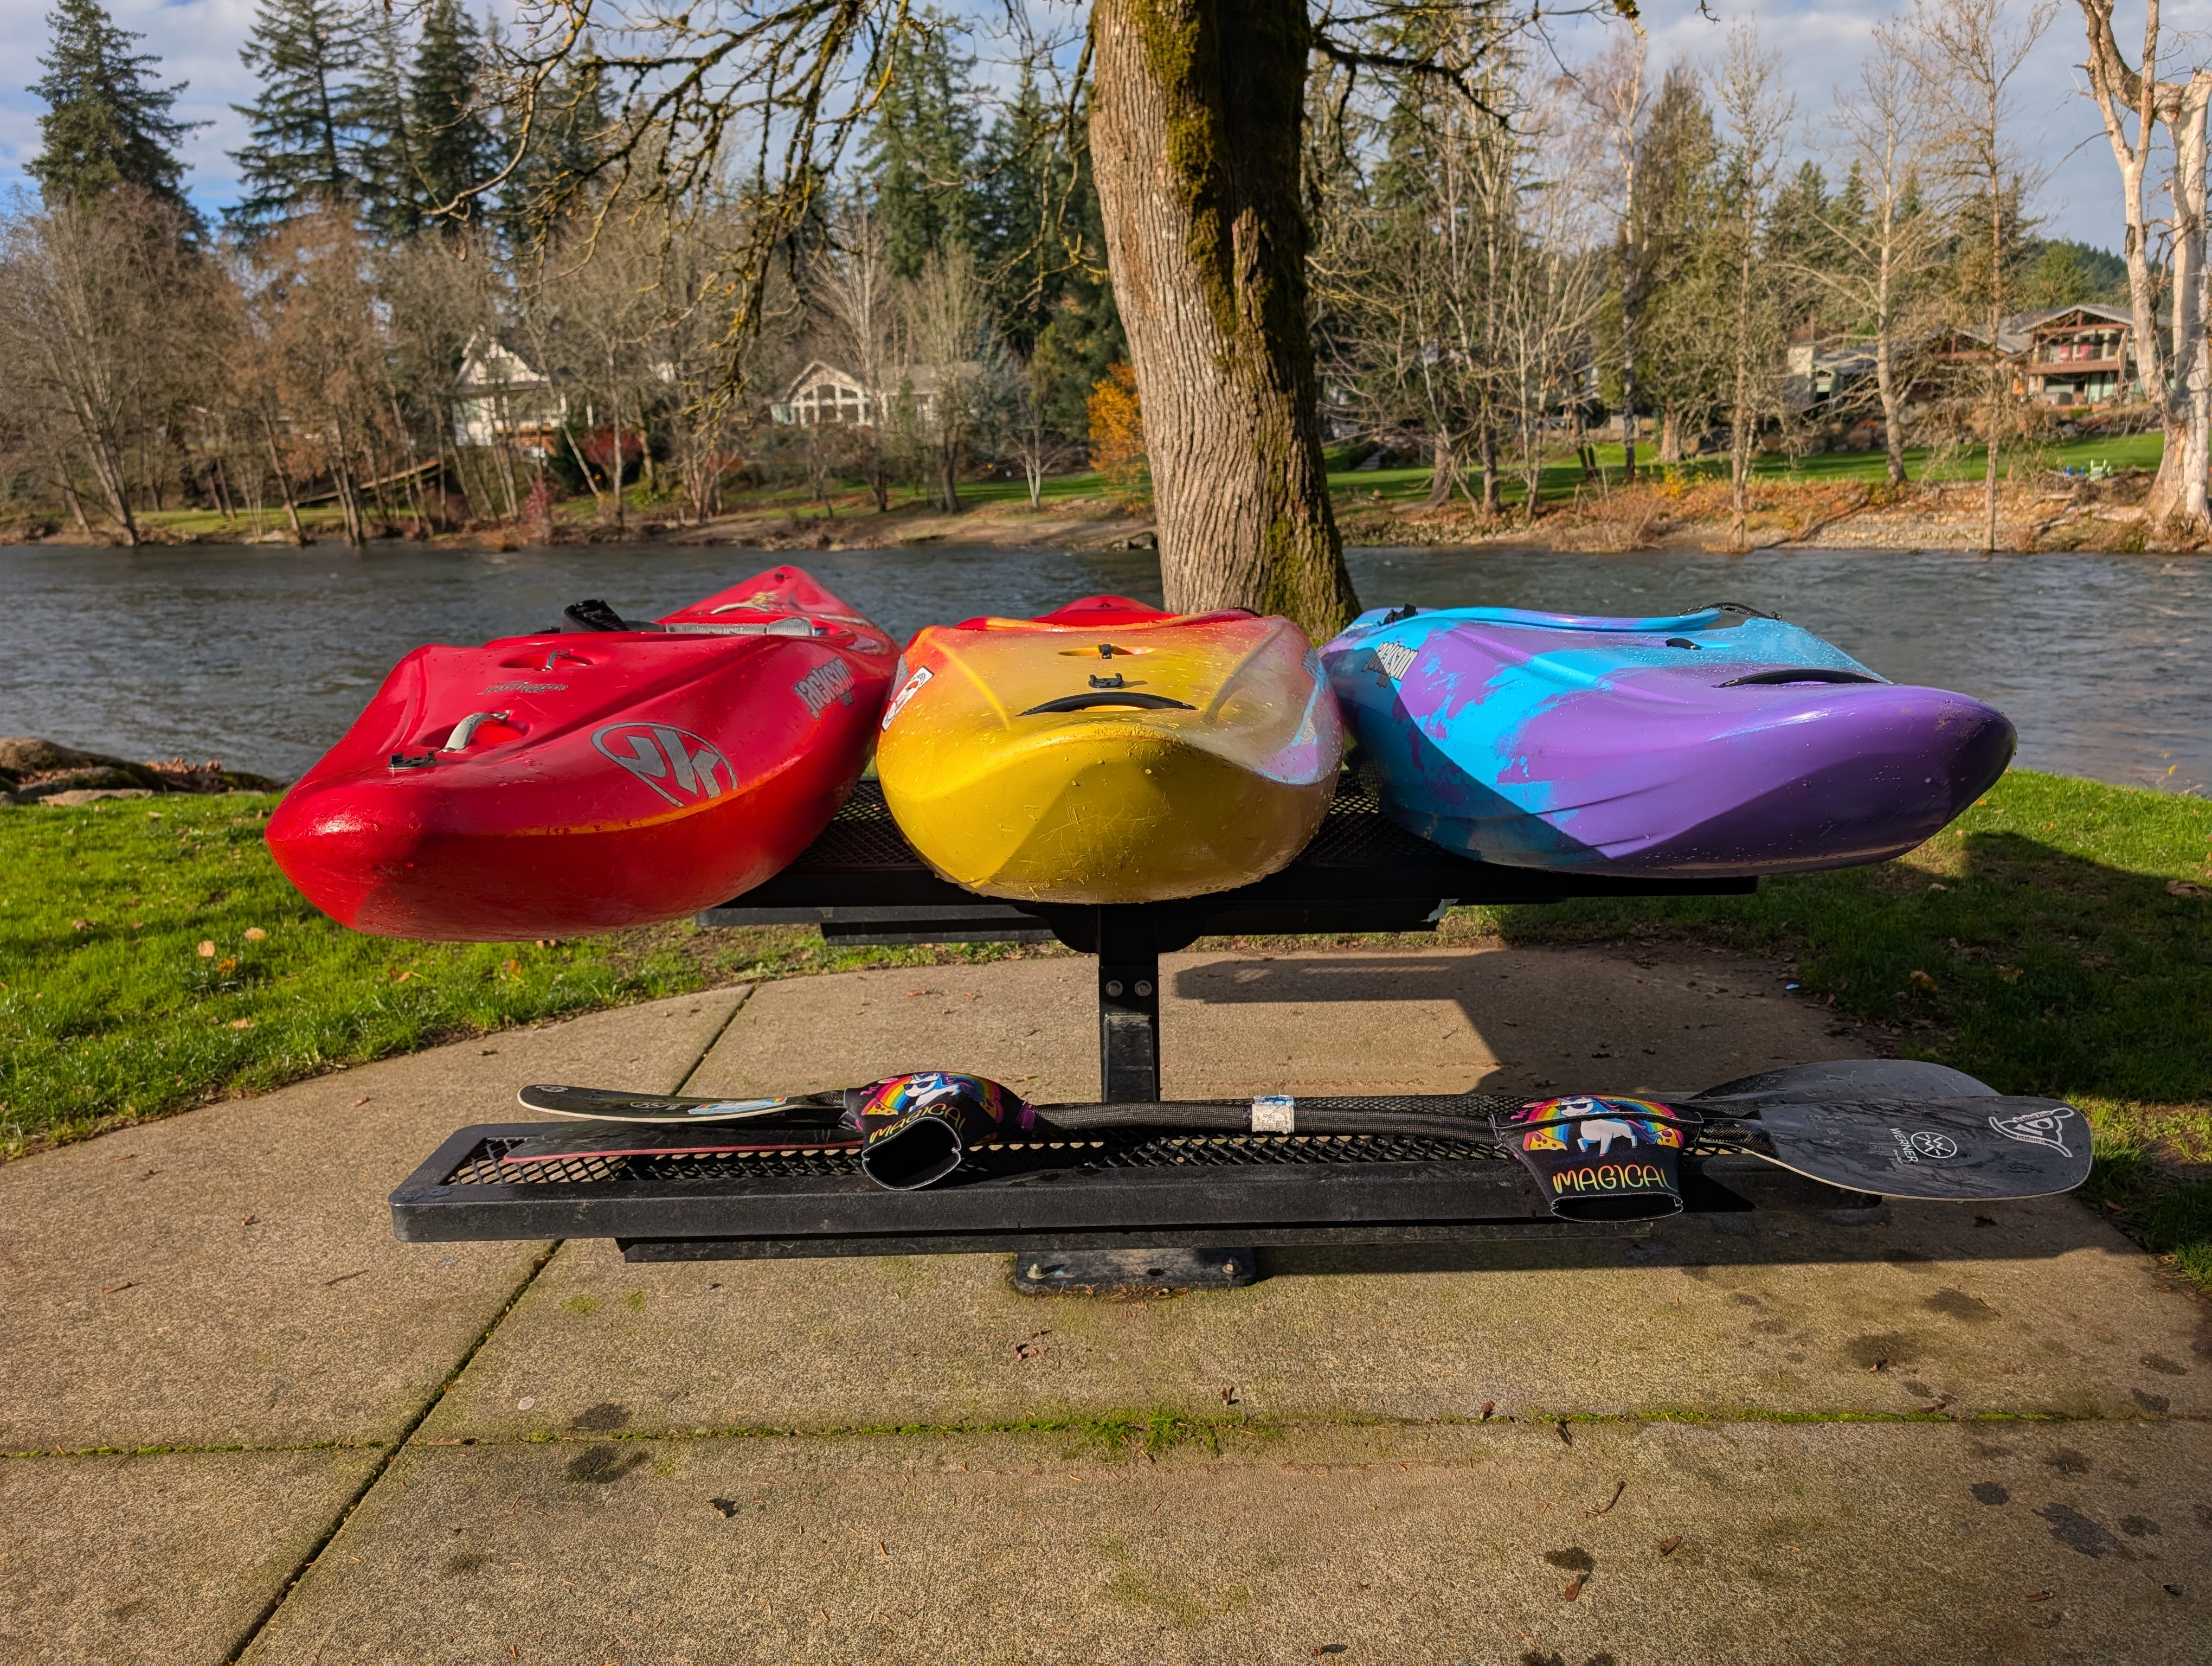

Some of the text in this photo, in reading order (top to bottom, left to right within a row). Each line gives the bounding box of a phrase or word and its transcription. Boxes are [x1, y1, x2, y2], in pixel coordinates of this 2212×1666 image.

[791, 657, 855, 720] Jackson
[869, 1103, 964, 1144] MAGICAL
[1889, 1127, 1919, 1162] WERNER
[1553, 1164, 1679, 1194] MAGICAL
